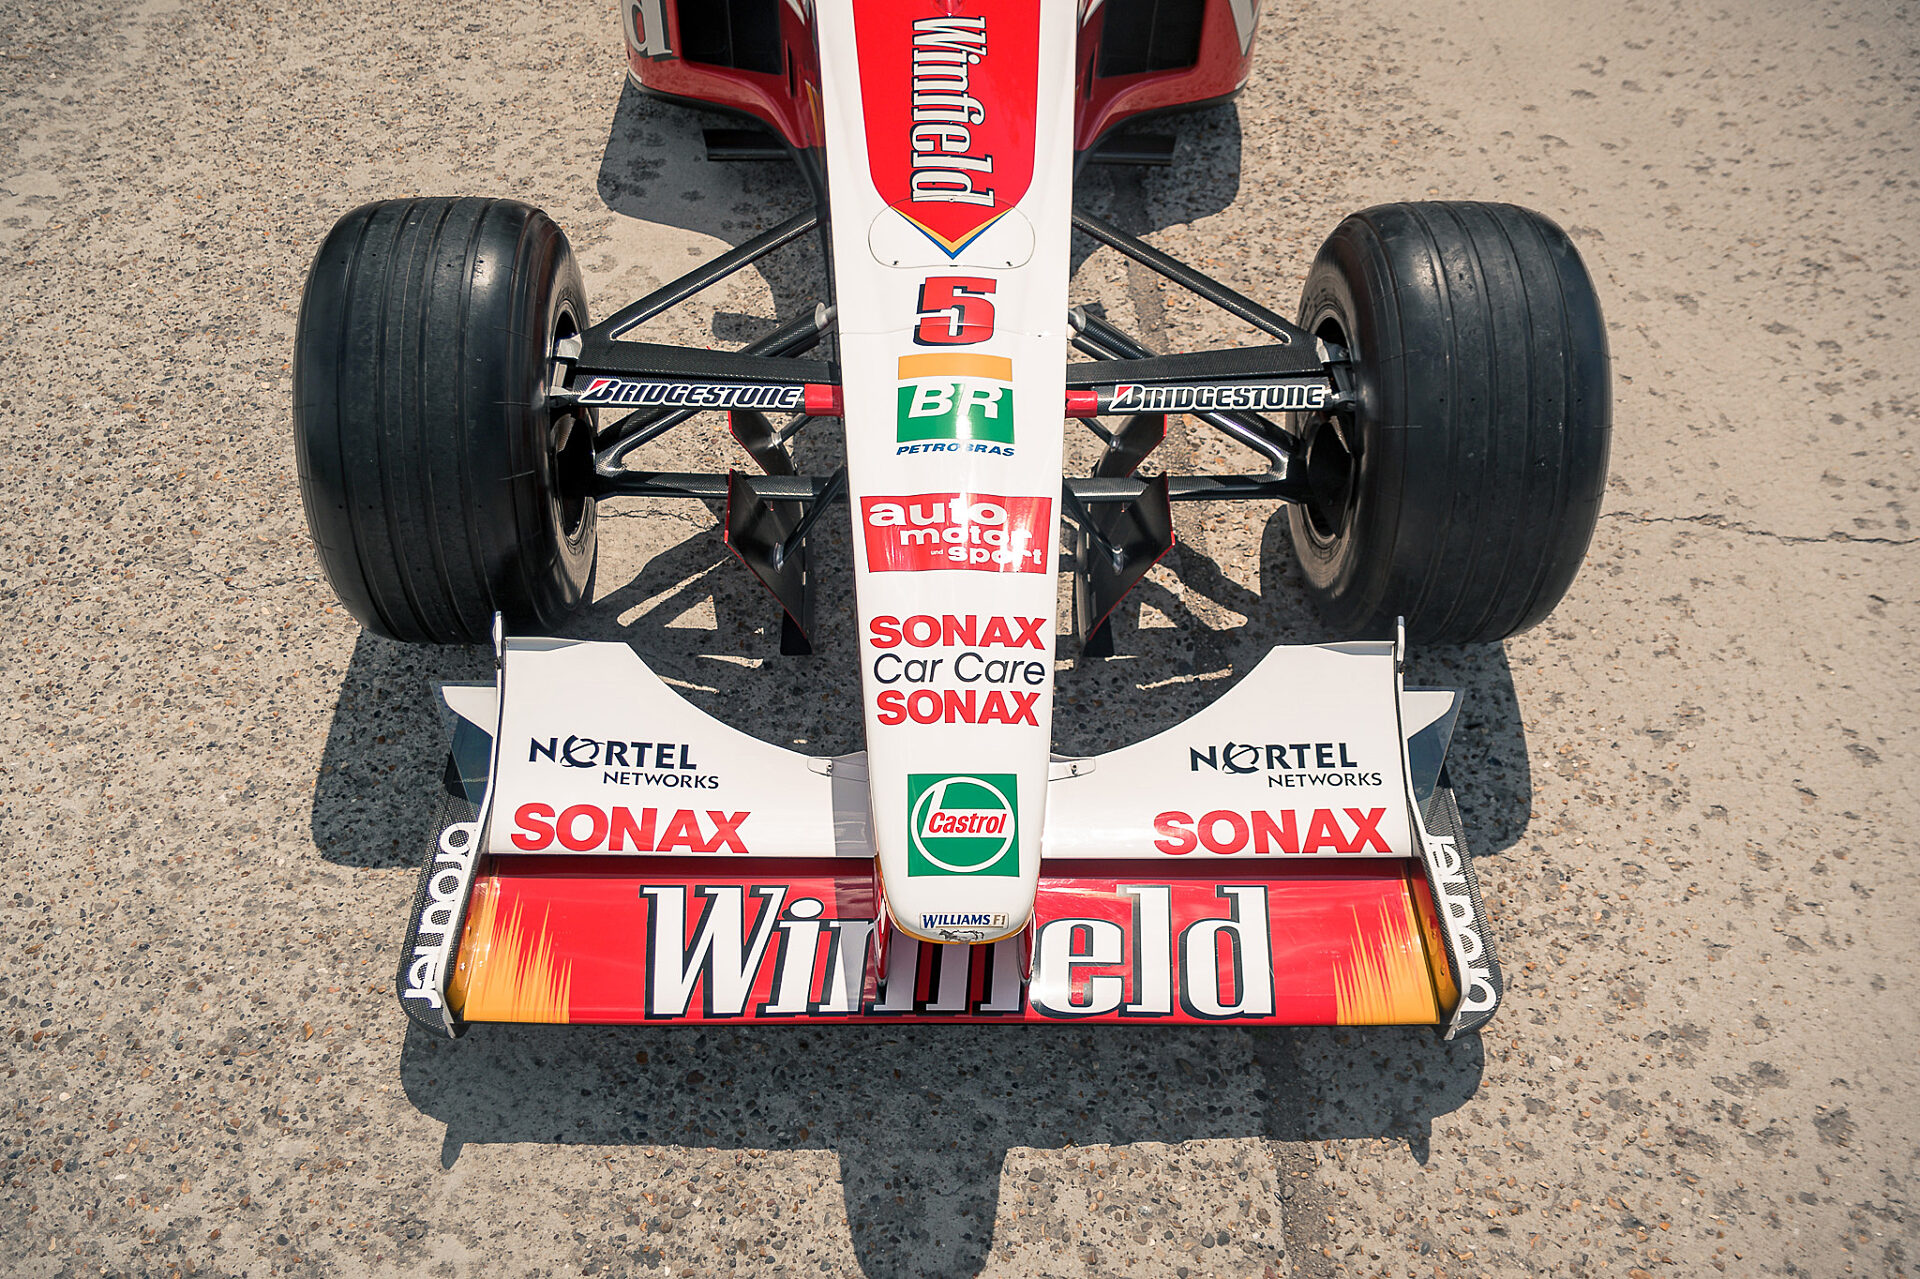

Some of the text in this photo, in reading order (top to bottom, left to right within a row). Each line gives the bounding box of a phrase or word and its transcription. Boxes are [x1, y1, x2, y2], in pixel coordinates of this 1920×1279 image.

[910, 15, 996, 208] Winfield
[912, 276, 998, 347] 5
[577, 377, 805, 409] BRIDGESTONE
[908, 382, 1003, 419] BR
[1108, 384, 1326, 412] BRIDGESTONE
[896, 443, 1015, 457] PETROBRAS
[868, 495, 1008, 528] auto
[900, 524, 1033, 547] motor
[947, 545, 1042, 566] sport
[869, 614, 1047, 651] SONAX
[873, 651, 1046, 684] Car Care
[876, 689, 1041, 727] SONAX
[528, 734, 698, 770] NORTEL
[1189, 740, 1359, 775] NORTEL
[603, 770, 720, 790] NETWORKS
[1268, 772, 1383, 788] NETWORKS
[510, 802, 751, 854] SONAX
[928, 812, 1007, 834] Castrol
[1153, 806, 1393, 855] SONAX
[922, 914, 1006, 929] WILLIAMS F1
